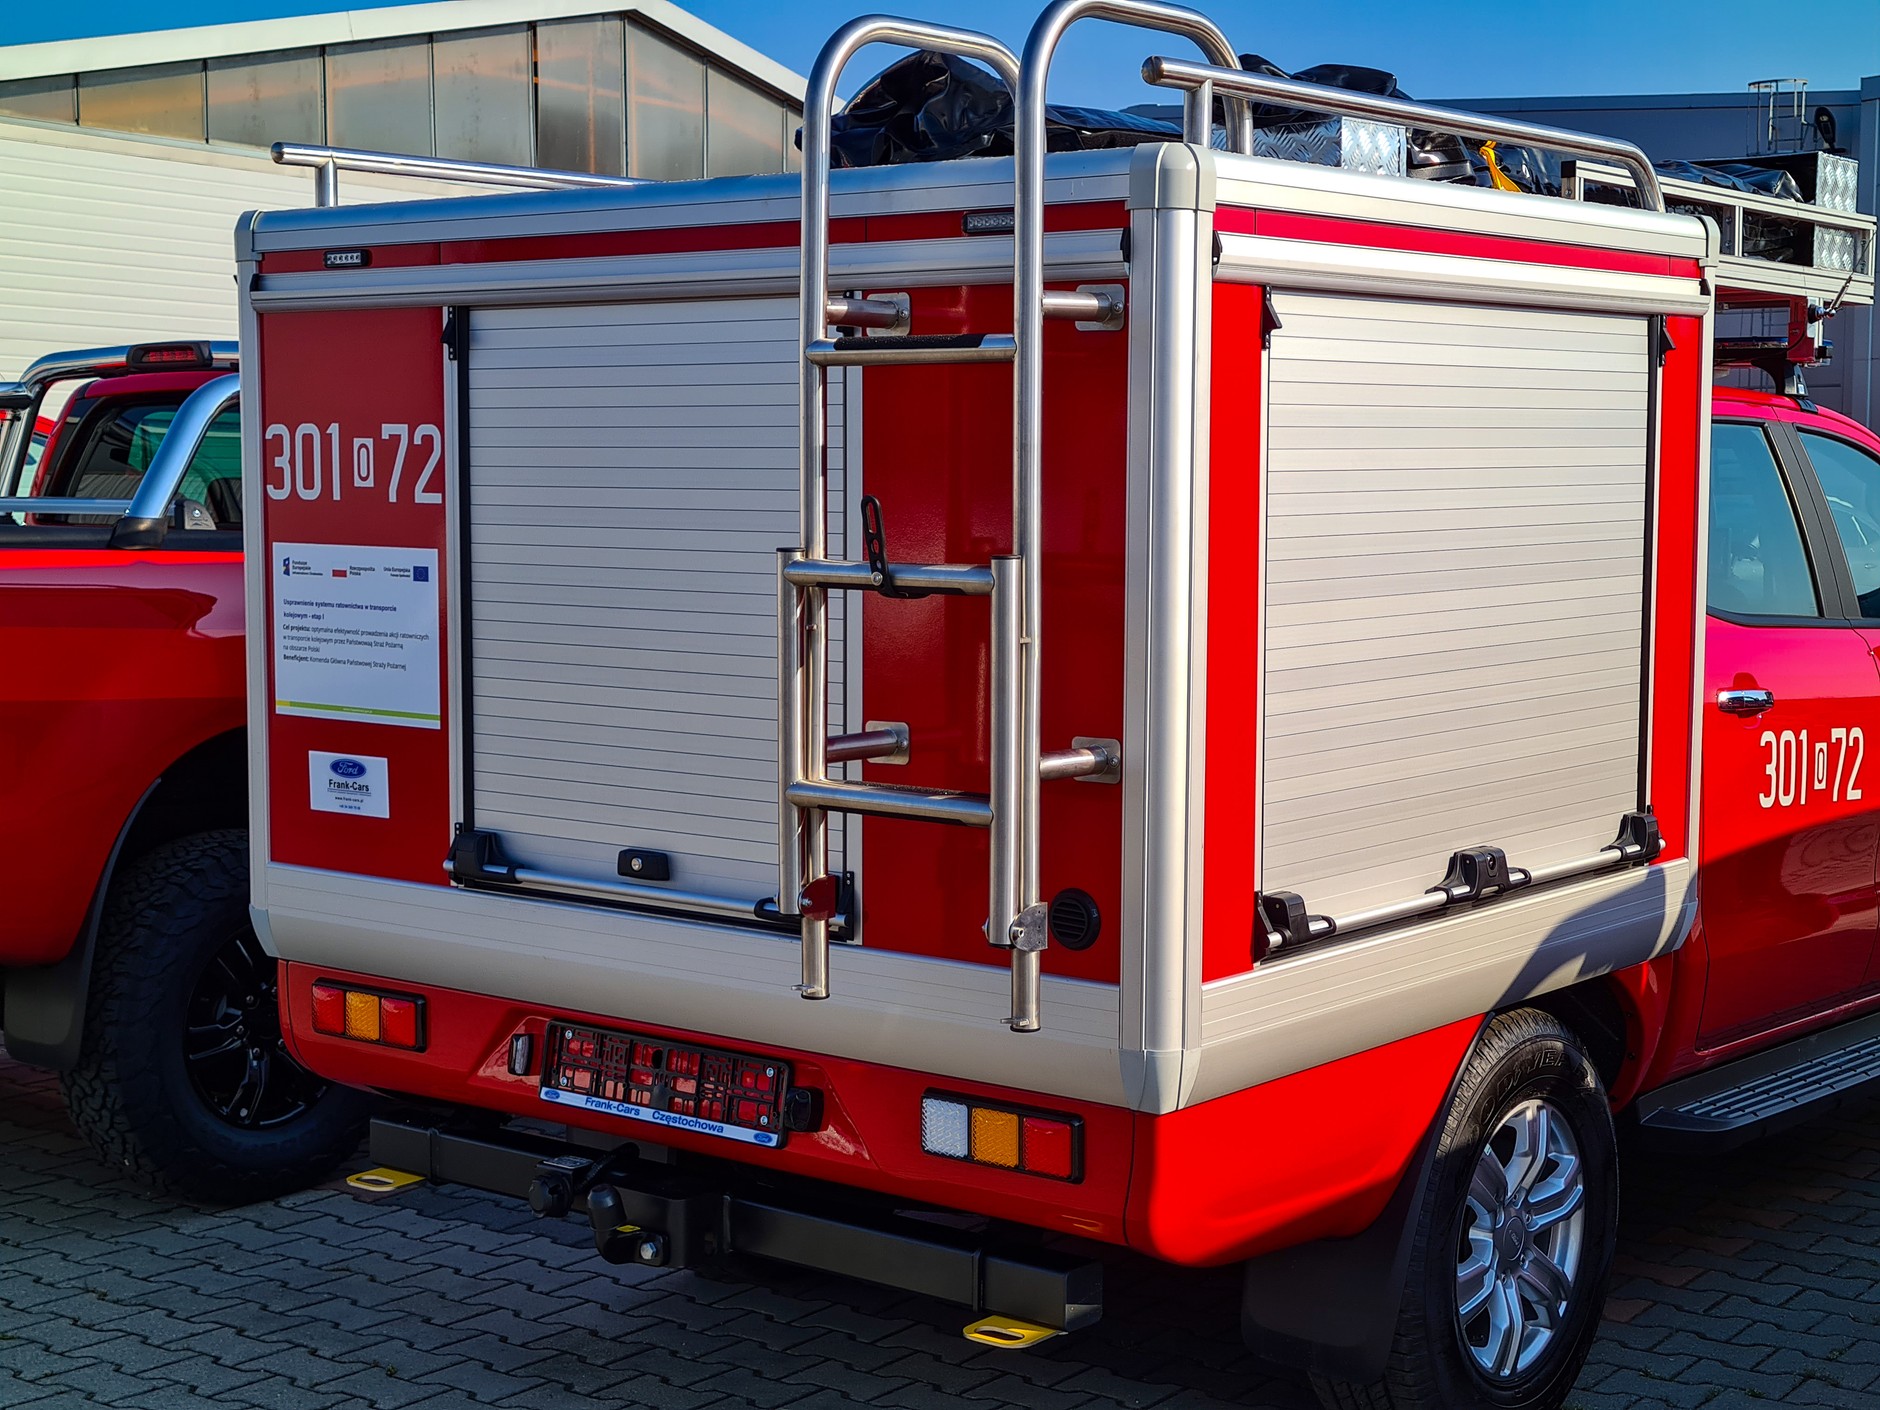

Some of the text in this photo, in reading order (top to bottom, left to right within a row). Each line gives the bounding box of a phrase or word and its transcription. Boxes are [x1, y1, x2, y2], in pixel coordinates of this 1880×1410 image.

[265, 423, 341, 500] 301
[382, 424, 442, 503] 72
[283, 599, 314, 607] Usprawnienie
[369, 604, 397, 612] transporcie
[283, 611, 308, 620] kolejowym
[311, 626, 333, 634] optymalna
[333, 627, 360, 636] efektywność
[360, 629, 388, 637] prowadzenia
[389, 631, 398, 639] akcji
[400, 632, 429, 641] ratowniczych
[311, 636, 333, 644] kolejowym
[330, 657, 346, 665] Główna
[347, 659, 372, 668] Państwowej
[373, 660, 385, 670] Straży
[1759, 729, 1807, 808] 301
[1831, 727, 1864, 802] 72
[328, 779, 370, 792] Frank-Cars
[585, 1097, 641, 1116] Frank-Cars
[652, 1110, 724, 1134] Częstochowa
